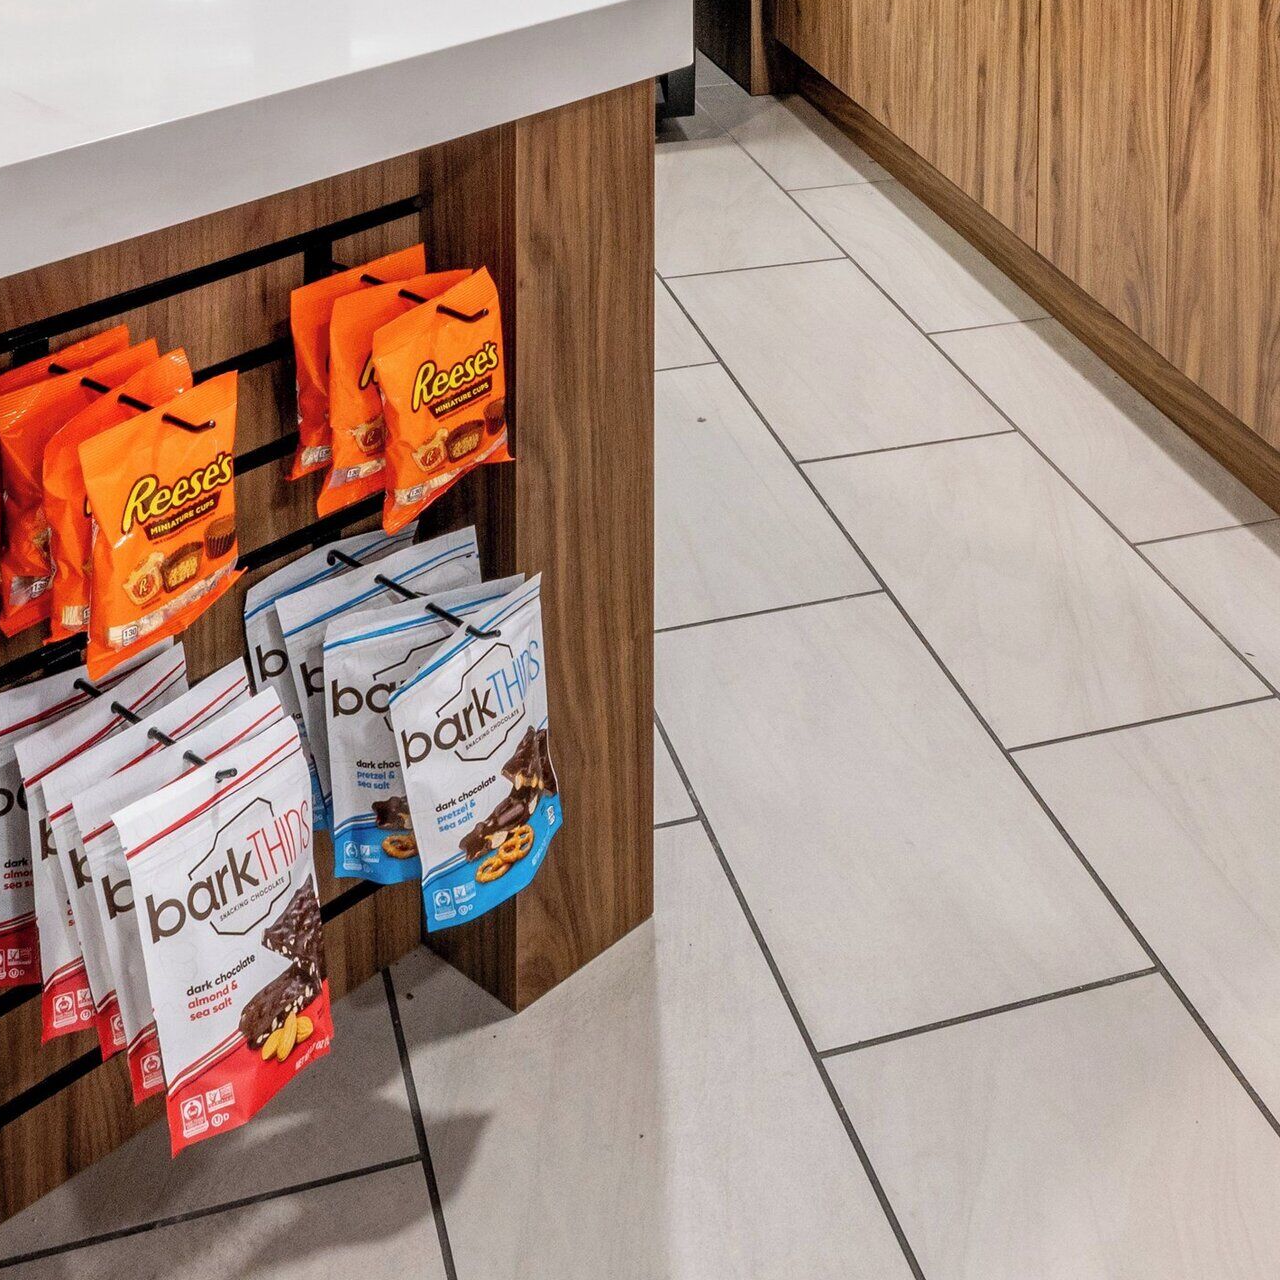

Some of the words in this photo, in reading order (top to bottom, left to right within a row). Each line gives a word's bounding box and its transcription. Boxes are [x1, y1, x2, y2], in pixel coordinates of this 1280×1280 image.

[413, 344, 498, 410] Reese's
[435, 392, 471, 414] MINIATURE
[473, 382, 489, 395] CUPS
[122, 454, 232, 532] Reese's
[150, 510, 194, 534] MINIATURE
[195, 499, 214, 514] CUPS
[124, 627, 137, 637] 130
[465, 726, 489, 751] SNACKING
[490, 709, 519, 733] CHOCOLATE
[356, 759, 376, 769] dark
[357, 771, 386, 782] pretzel
[358, 780, 371, 788] sea
[373, 781, 390, 790] salt
[435, 798, 457, 812] dark
[459, 774, 496, 802] chocolate
[437, 806, 468, 825] pretzel
[469, 800, 476, 808] &
[438, 822, 455, 833] sea
[457, 811, 474, 826] salt
[4, 859, 28, 868] dark
[219, 897, 249, 921] SNACKING
[251, 877, 285, 902] CHOCOLATE
[186, 979, 213, 997] dark
[215, 954, 256, 984] chocolate
[188, 988, 229, 1009] almond
[190, 1009, 209, 1021] sea
[211, 997, 232, 1013] salt
